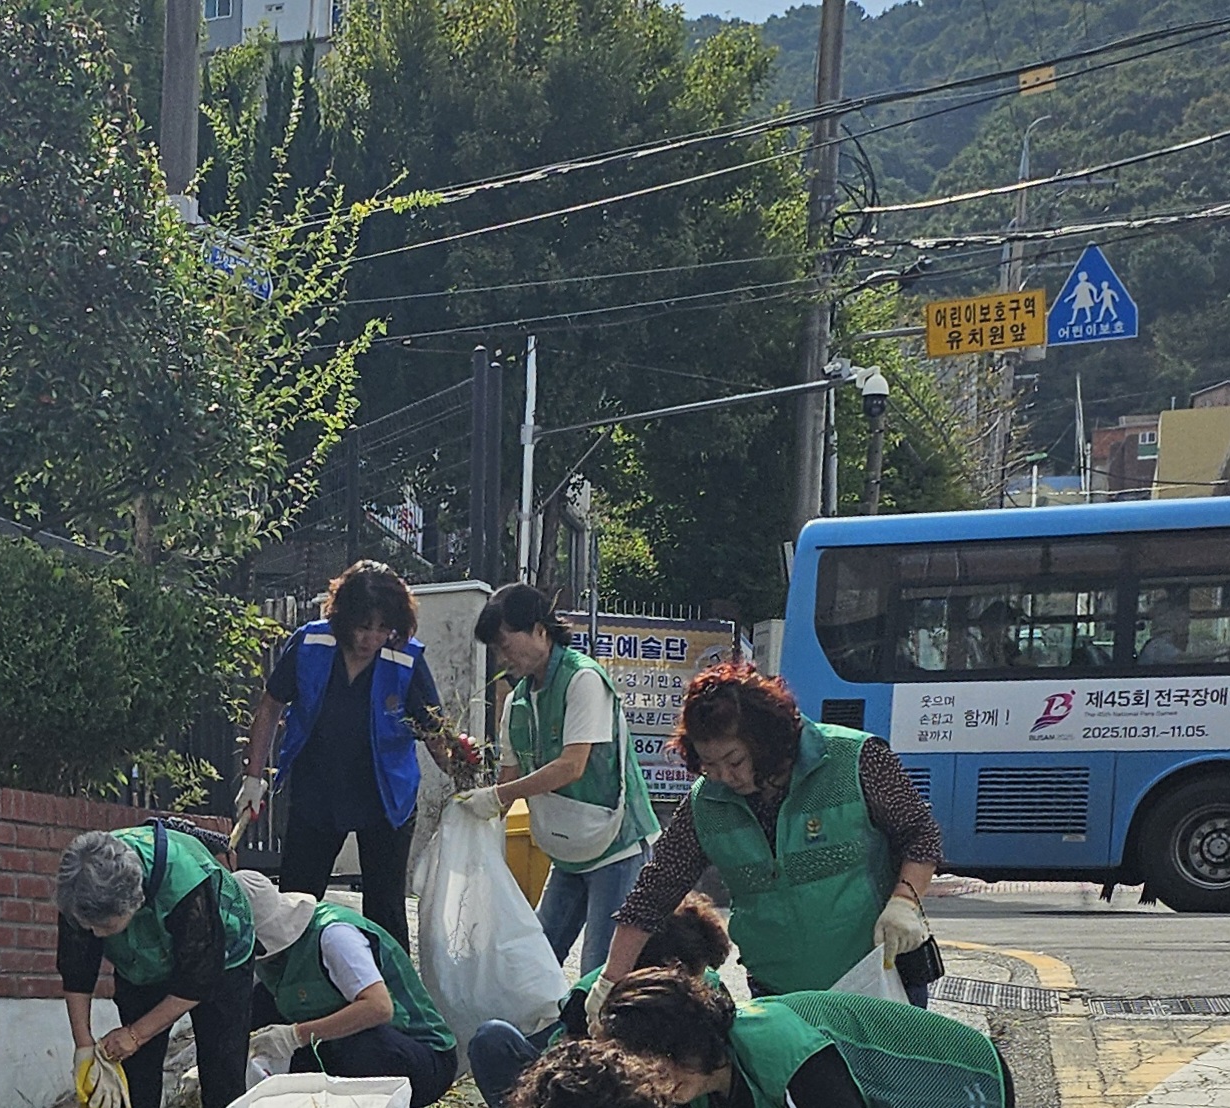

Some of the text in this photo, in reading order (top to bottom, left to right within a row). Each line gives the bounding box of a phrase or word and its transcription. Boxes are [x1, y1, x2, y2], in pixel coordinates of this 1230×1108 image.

[935, 296, 1036, 329] 어린이보호구역
[1058, 320, 1125, 339] 어린이보호
[571, 633, 688, 661] 랑골예술단
[920, 695, 956, 709] 웃으며
[1085, 687, 1230, 709] 제45회 전국장애
[920, 713, 954, 726] 손잡고
[917, 730, 953, 742] 끝까지
